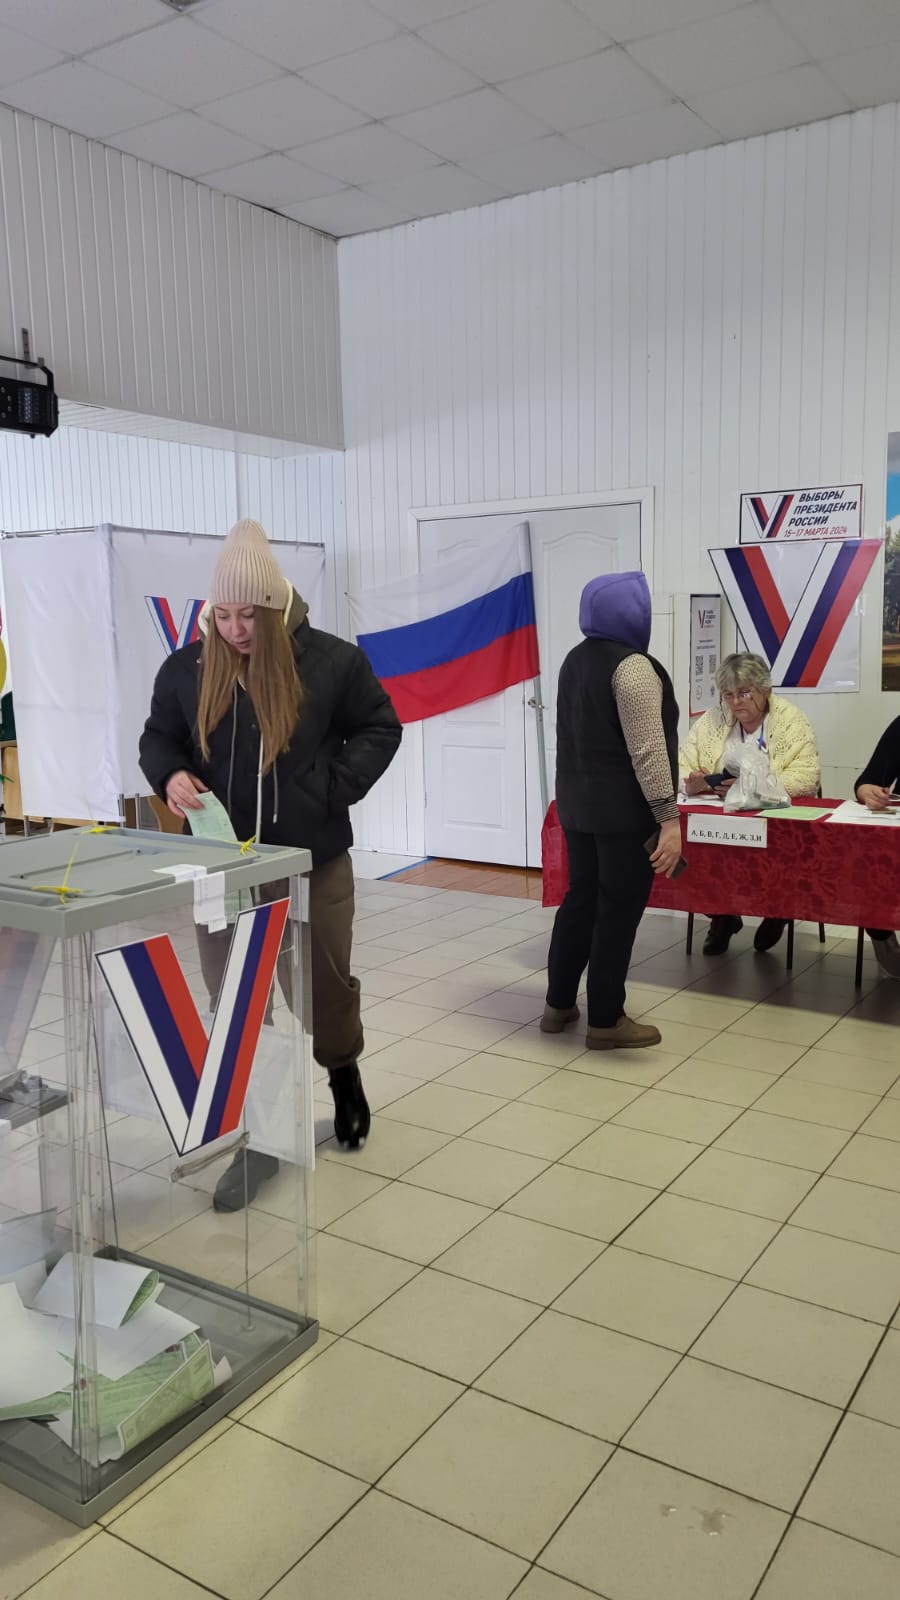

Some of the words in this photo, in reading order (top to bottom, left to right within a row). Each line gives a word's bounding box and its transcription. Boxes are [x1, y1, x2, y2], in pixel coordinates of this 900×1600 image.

[799, 490, 844, 502] ВЫБОРЫ
[793, 501, 857, 514] ПРЕЗИДЕНТА
[788, 515, 829, 527] РОССИИ
[804, 527, 829, 536] МАРТА
[829, 526, 848, 535] 2024
